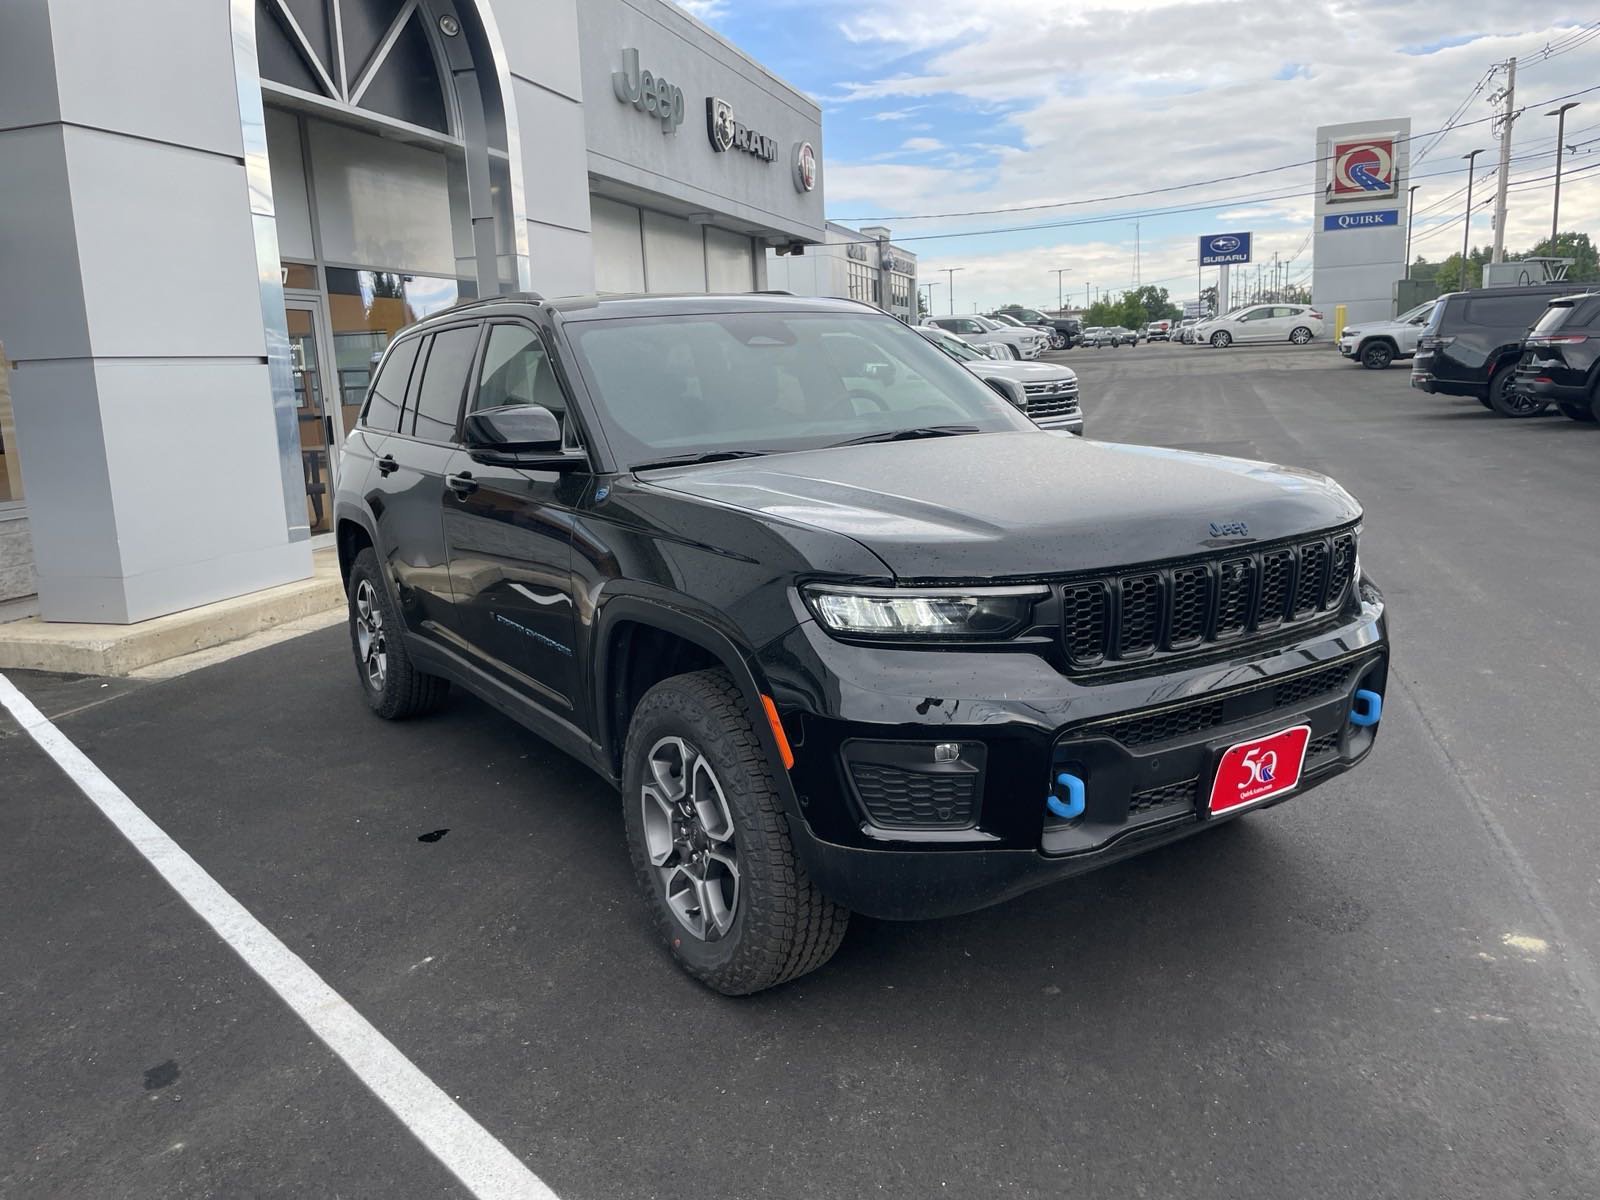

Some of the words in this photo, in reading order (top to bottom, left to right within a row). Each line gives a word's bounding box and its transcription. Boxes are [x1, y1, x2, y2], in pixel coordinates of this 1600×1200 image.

[612, 47, 685, 137] Jeep
[734, 121, 784, 161] RAM
[1338, 214, 1384, 228] QUIRK
[1203, 254, 1247, 263] SUBARU
[1208, 521, 1249, 537] Jeep
